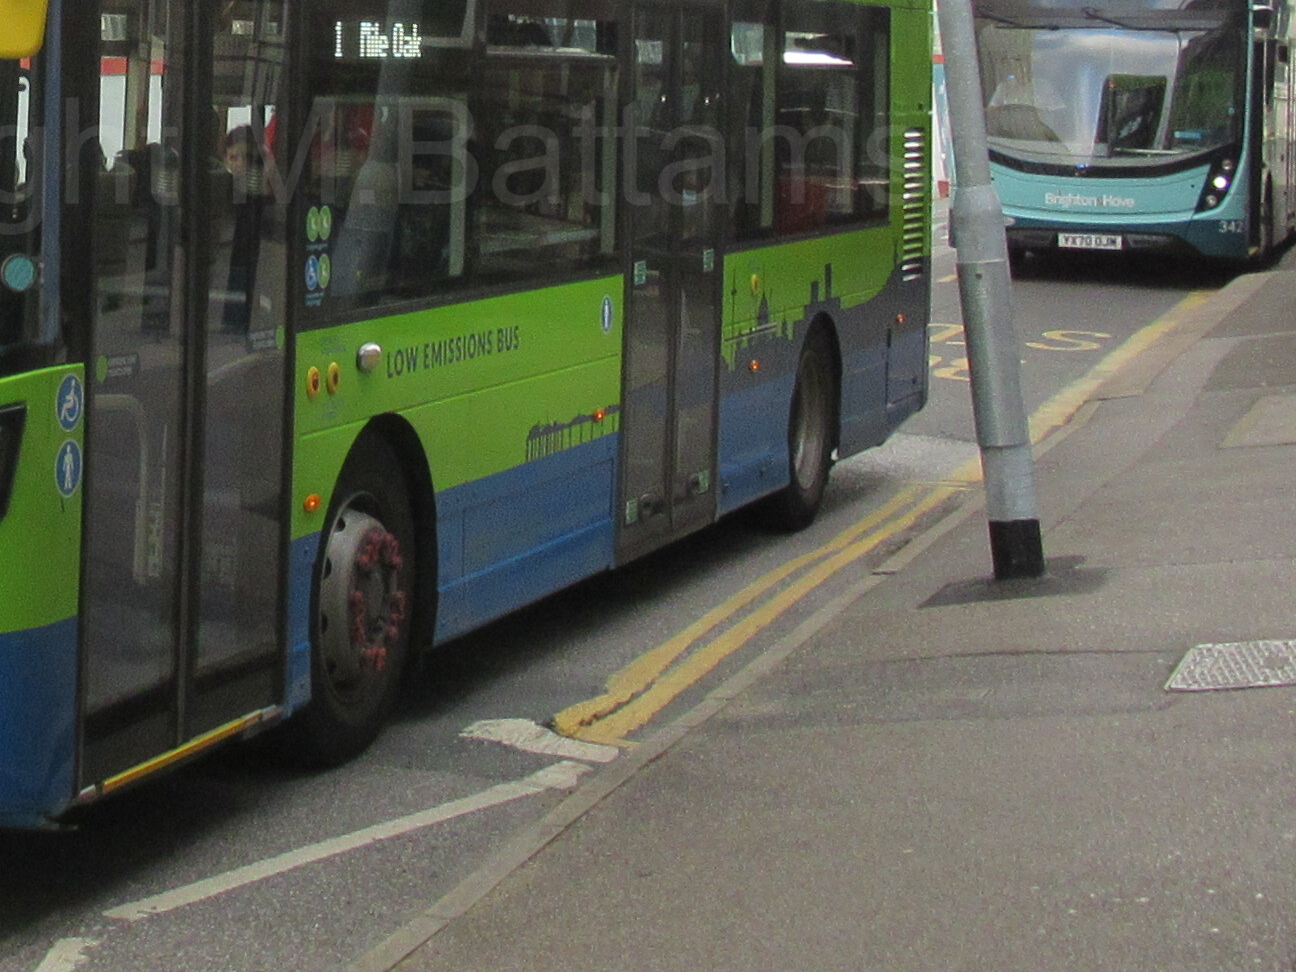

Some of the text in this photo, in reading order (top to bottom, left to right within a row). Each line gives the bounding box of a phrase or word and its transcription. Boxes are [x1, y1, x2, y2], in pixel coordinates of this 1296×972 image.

[386, 345, 418, 379] LOW
[422, 330, 494, 370] EMISSIONS
[496, 325, 520, 353] BUS
